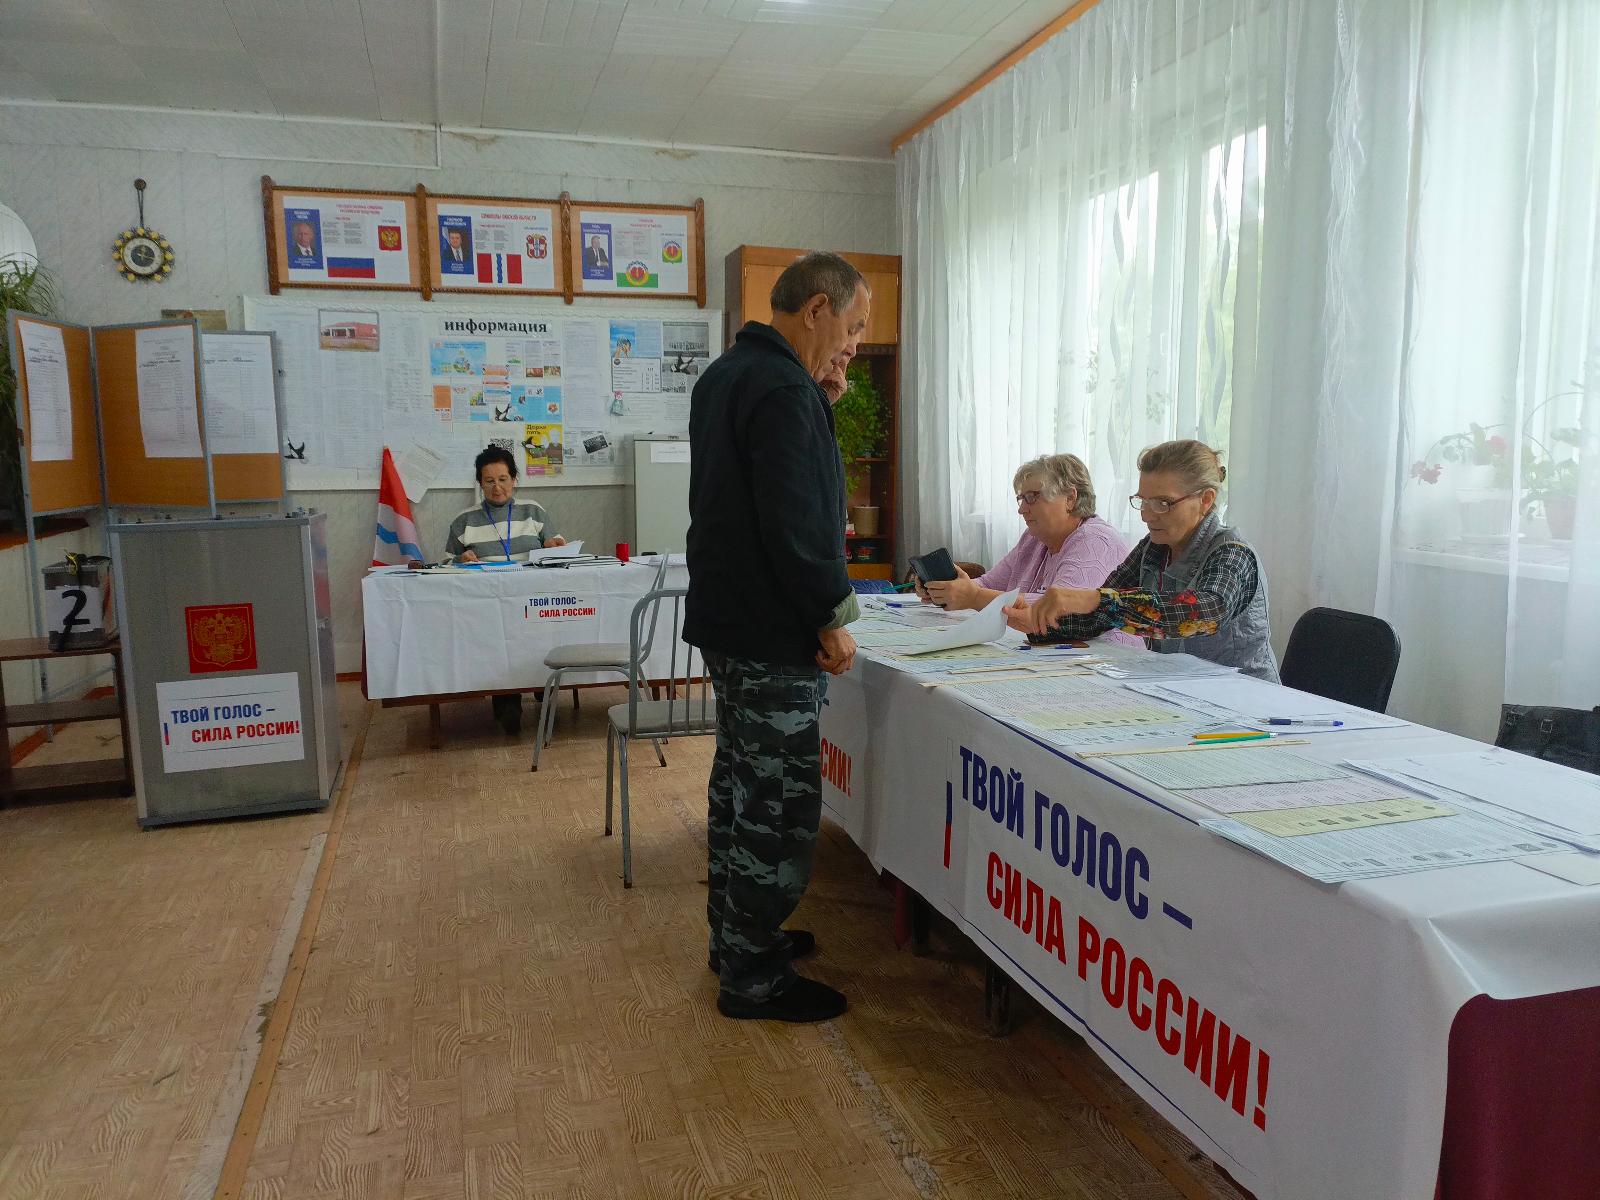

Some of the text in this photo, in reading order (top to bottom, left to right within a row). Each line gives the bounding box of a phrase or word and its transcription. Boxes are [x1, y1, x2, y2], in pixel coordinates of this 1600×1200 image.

[444, 318, 547, 334] информация
[61, 589, 90, 626] 2
[529, 597, 549, 607] ТВОЙ
[551, 596, 577, 606] ГОЛОС
[539, 607, 596, 618] СИЛА РОССИИ!
[170, 706, 210, 725] ТВОЙ
[213, 703, 262, 721] ГОЛОС
[191, 720, 300, 743] СИЛА РОССИИ!
[820, 737, 852, 798] СИИ!
[959, 745, 1025, 839] ТВОЙ
[1034, 790, 1150, 920] ГОЛОС
[986, 851, 1271, 1132] СИЛА РОССИИ!
